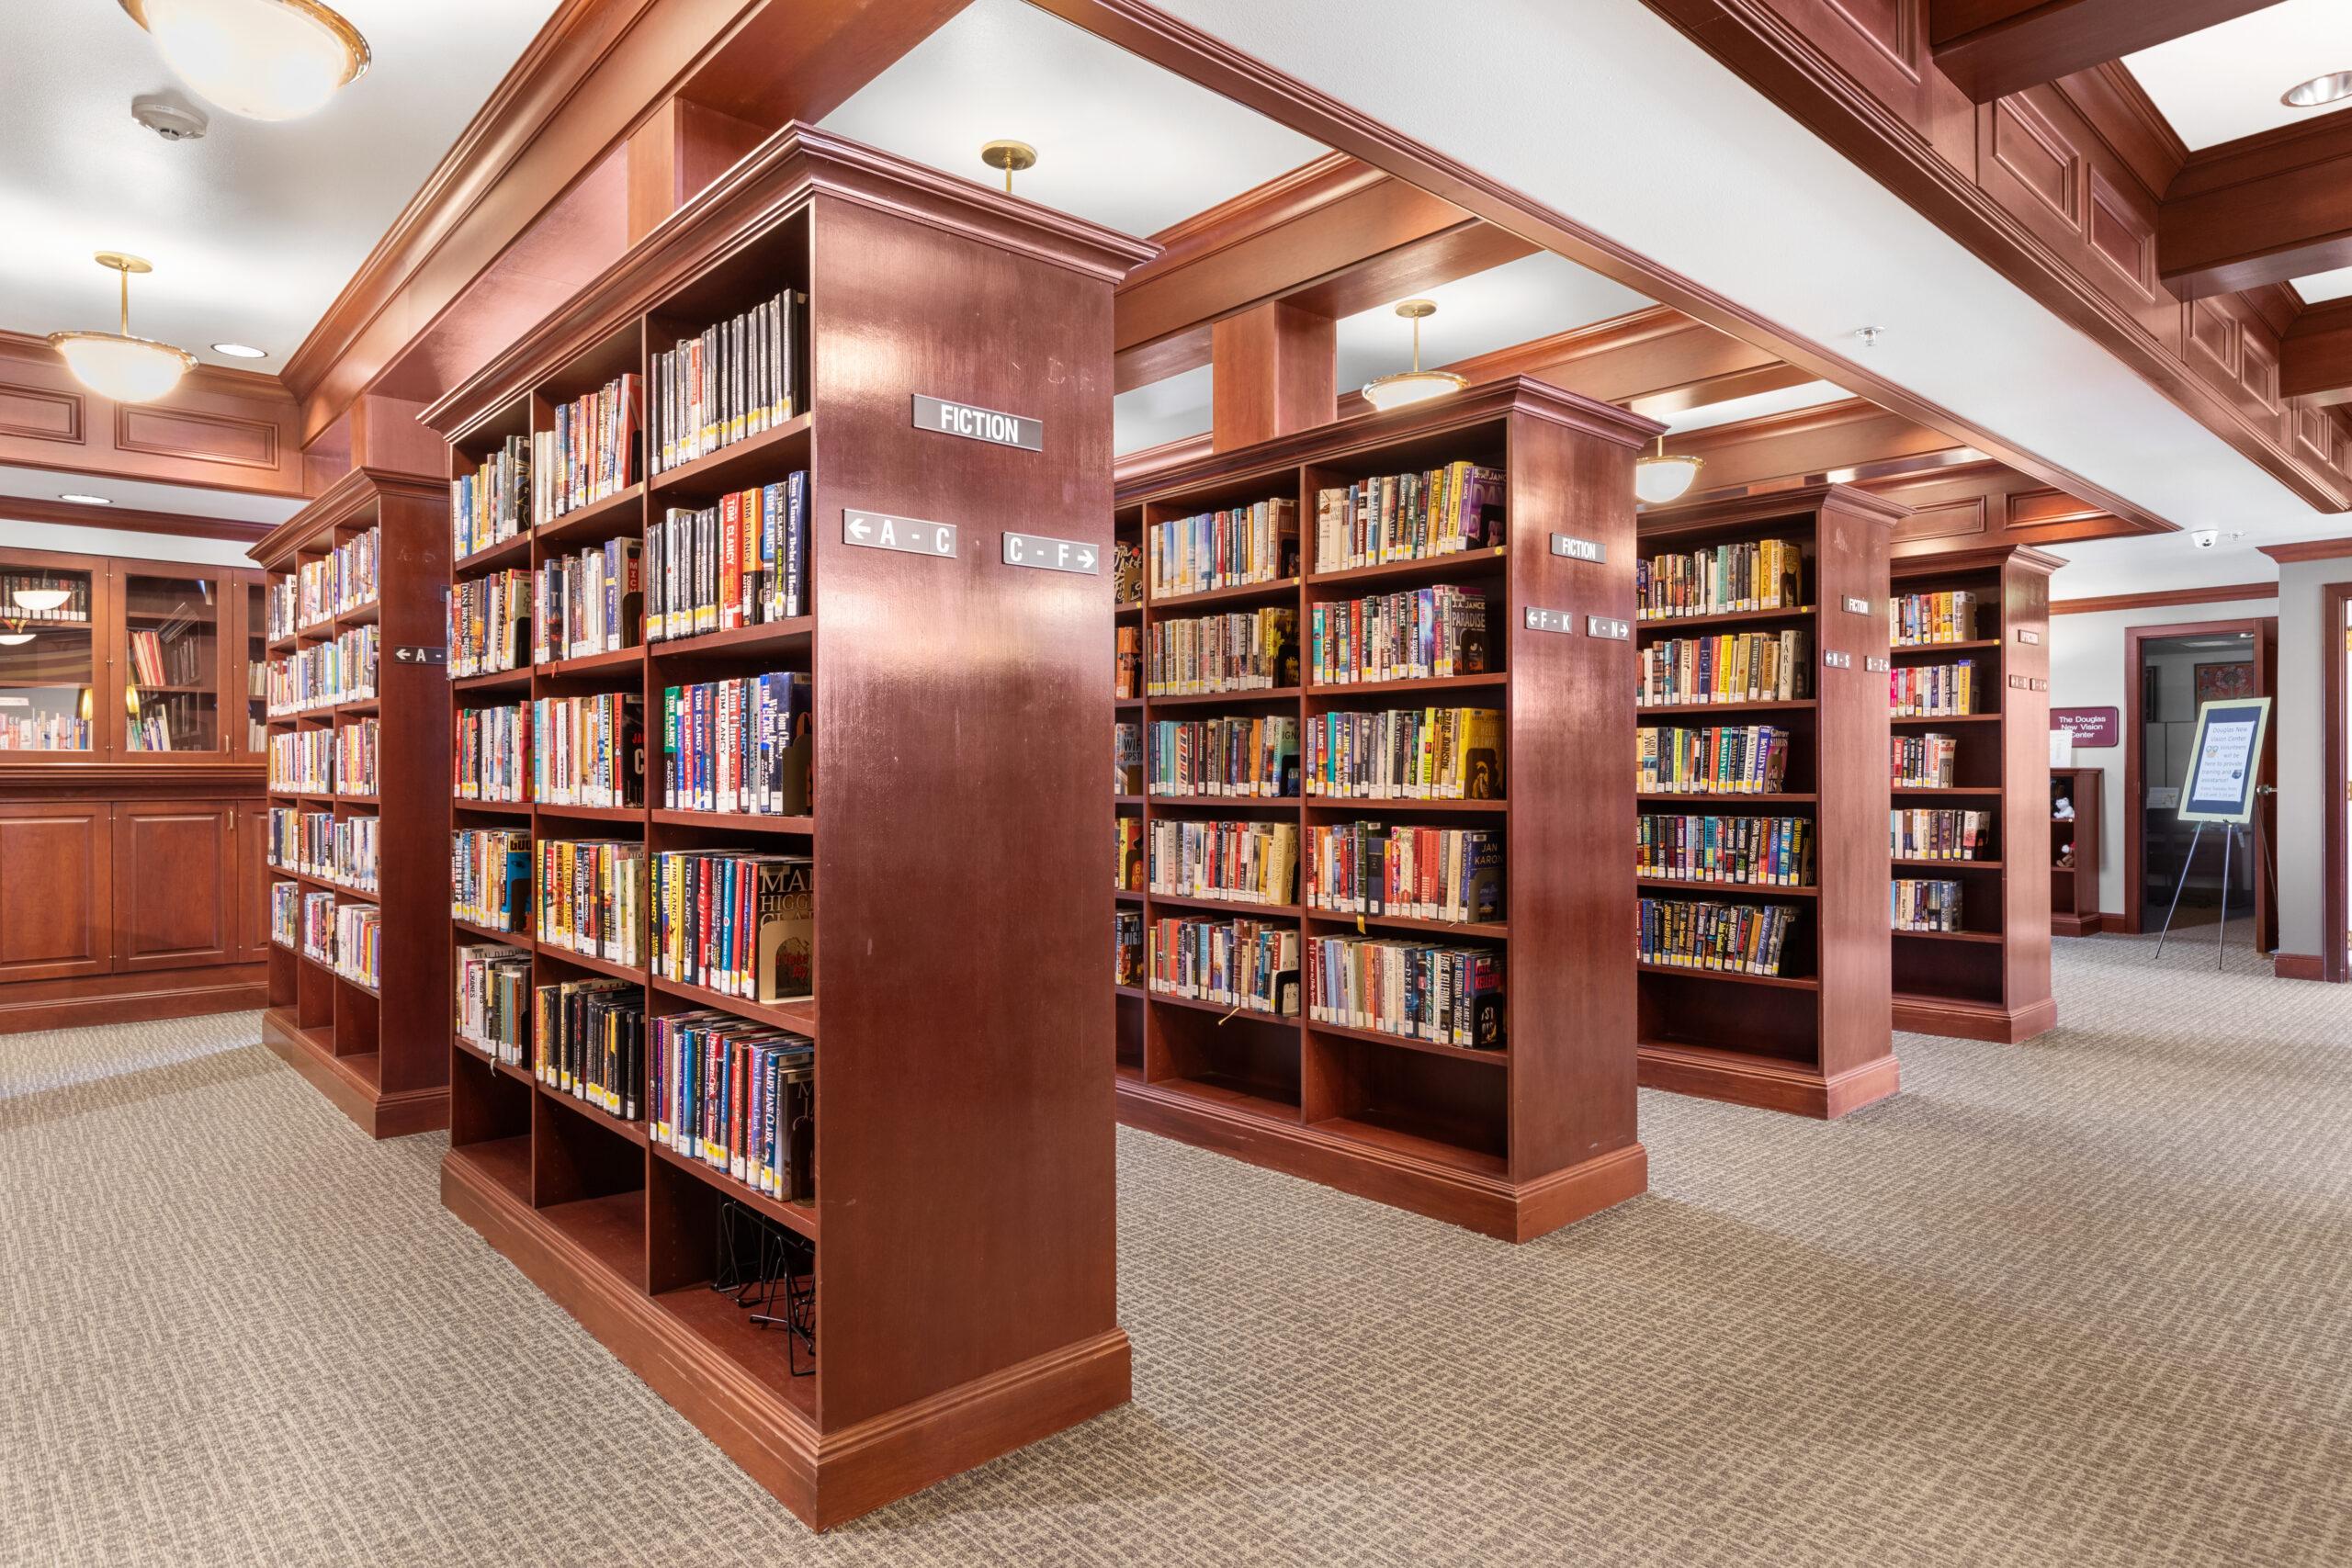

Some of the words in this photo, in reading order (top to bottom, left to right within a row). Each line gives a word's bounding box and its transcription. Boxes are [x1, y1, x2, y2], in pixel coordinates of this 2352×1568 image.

[941, 404, 1018, 444] FICTION
[790, 475, 798, 496] Tom
[727, 500, 735, 522] TOM
[789, 499, 797, 533] Clancy
[726, 525, 735, 564] CLANCY
[766, 514, 775, 554] CLANCY
[880, 520, 896, 546] A
[936, 527, 949, 553] C
[789, 536, 797, 561] Debt
[1011, 537, 1022, 561] C
[1058, 545, 1069, 566] F
[1563, 538, 1595, 559] FICTION
[788, 563, 797, 572] of
[1849, 598, 1868, 614] FICTION
[1542, 612, 1547, 627] F
[1563, 615, 1569, 630] K
[1591, 619, 1597, 635] K
[1612, 622, 1618, 637] N
[416, 649, 426, 661] A
[1834, 653, 1838, 665] N
[1846, 655, 1849, 667] S
[1868, 658, 1871, 670] S
[1880, 660, 1883, 671] Z
[768, 699, 777, 732] Without
[778, 712, 789, 728] Tom
[1442, 712, 1452, 733] CRAIG
[729, 716, 739, 754] Clancy
[768, 736, 777, 774] Remorse
[1441, 736, 1452, 770] JOHNSON
[1749, 836, 1758, 862] SANDFORD
[1729, 908, 1738, 922] JOHN
[1727, 923, 1737, 952] SANDFORD
[1441, 956, 1451, 972] FAYE
[1454, 956, 1464, 969] FAYE
[1441, 974, 1451, 1010] KELLERMAN
[1454, 970, 1464, 998] KELLERMAN
[753, 1054, 762, 1074] Mary
[766, 1066, 775, 1091] MARY
[752, 1077, 761, 1107] Higgins
[765, 1091, 775, 1113] JANE
[765, 1113, 774, 1144] CLARK
